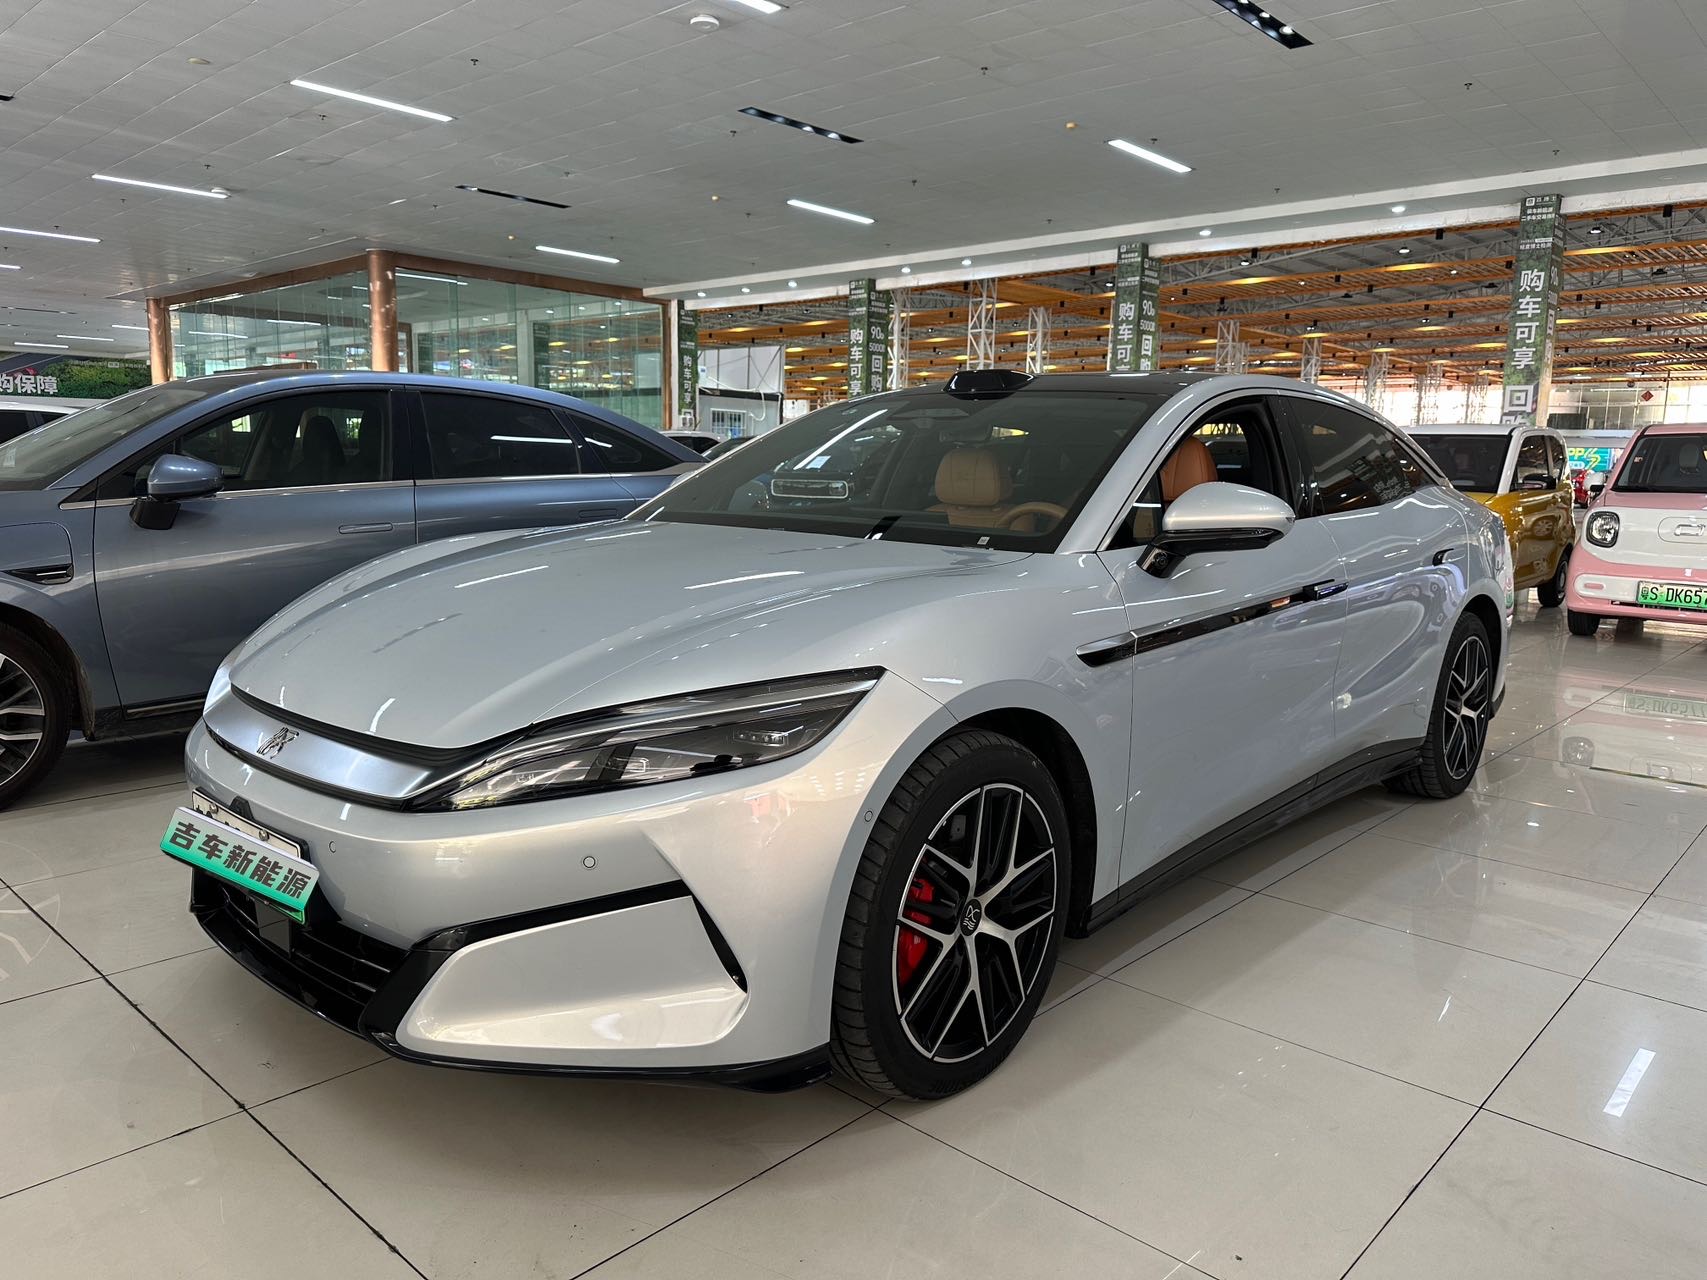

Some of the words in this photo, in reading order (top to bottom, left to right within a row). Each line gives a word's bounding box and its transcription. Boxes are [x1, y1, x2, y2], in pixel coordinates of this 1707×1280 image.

[849, 328, 864, 396] 购车可享
[169, 820, 312, 899] 吉车新能源
